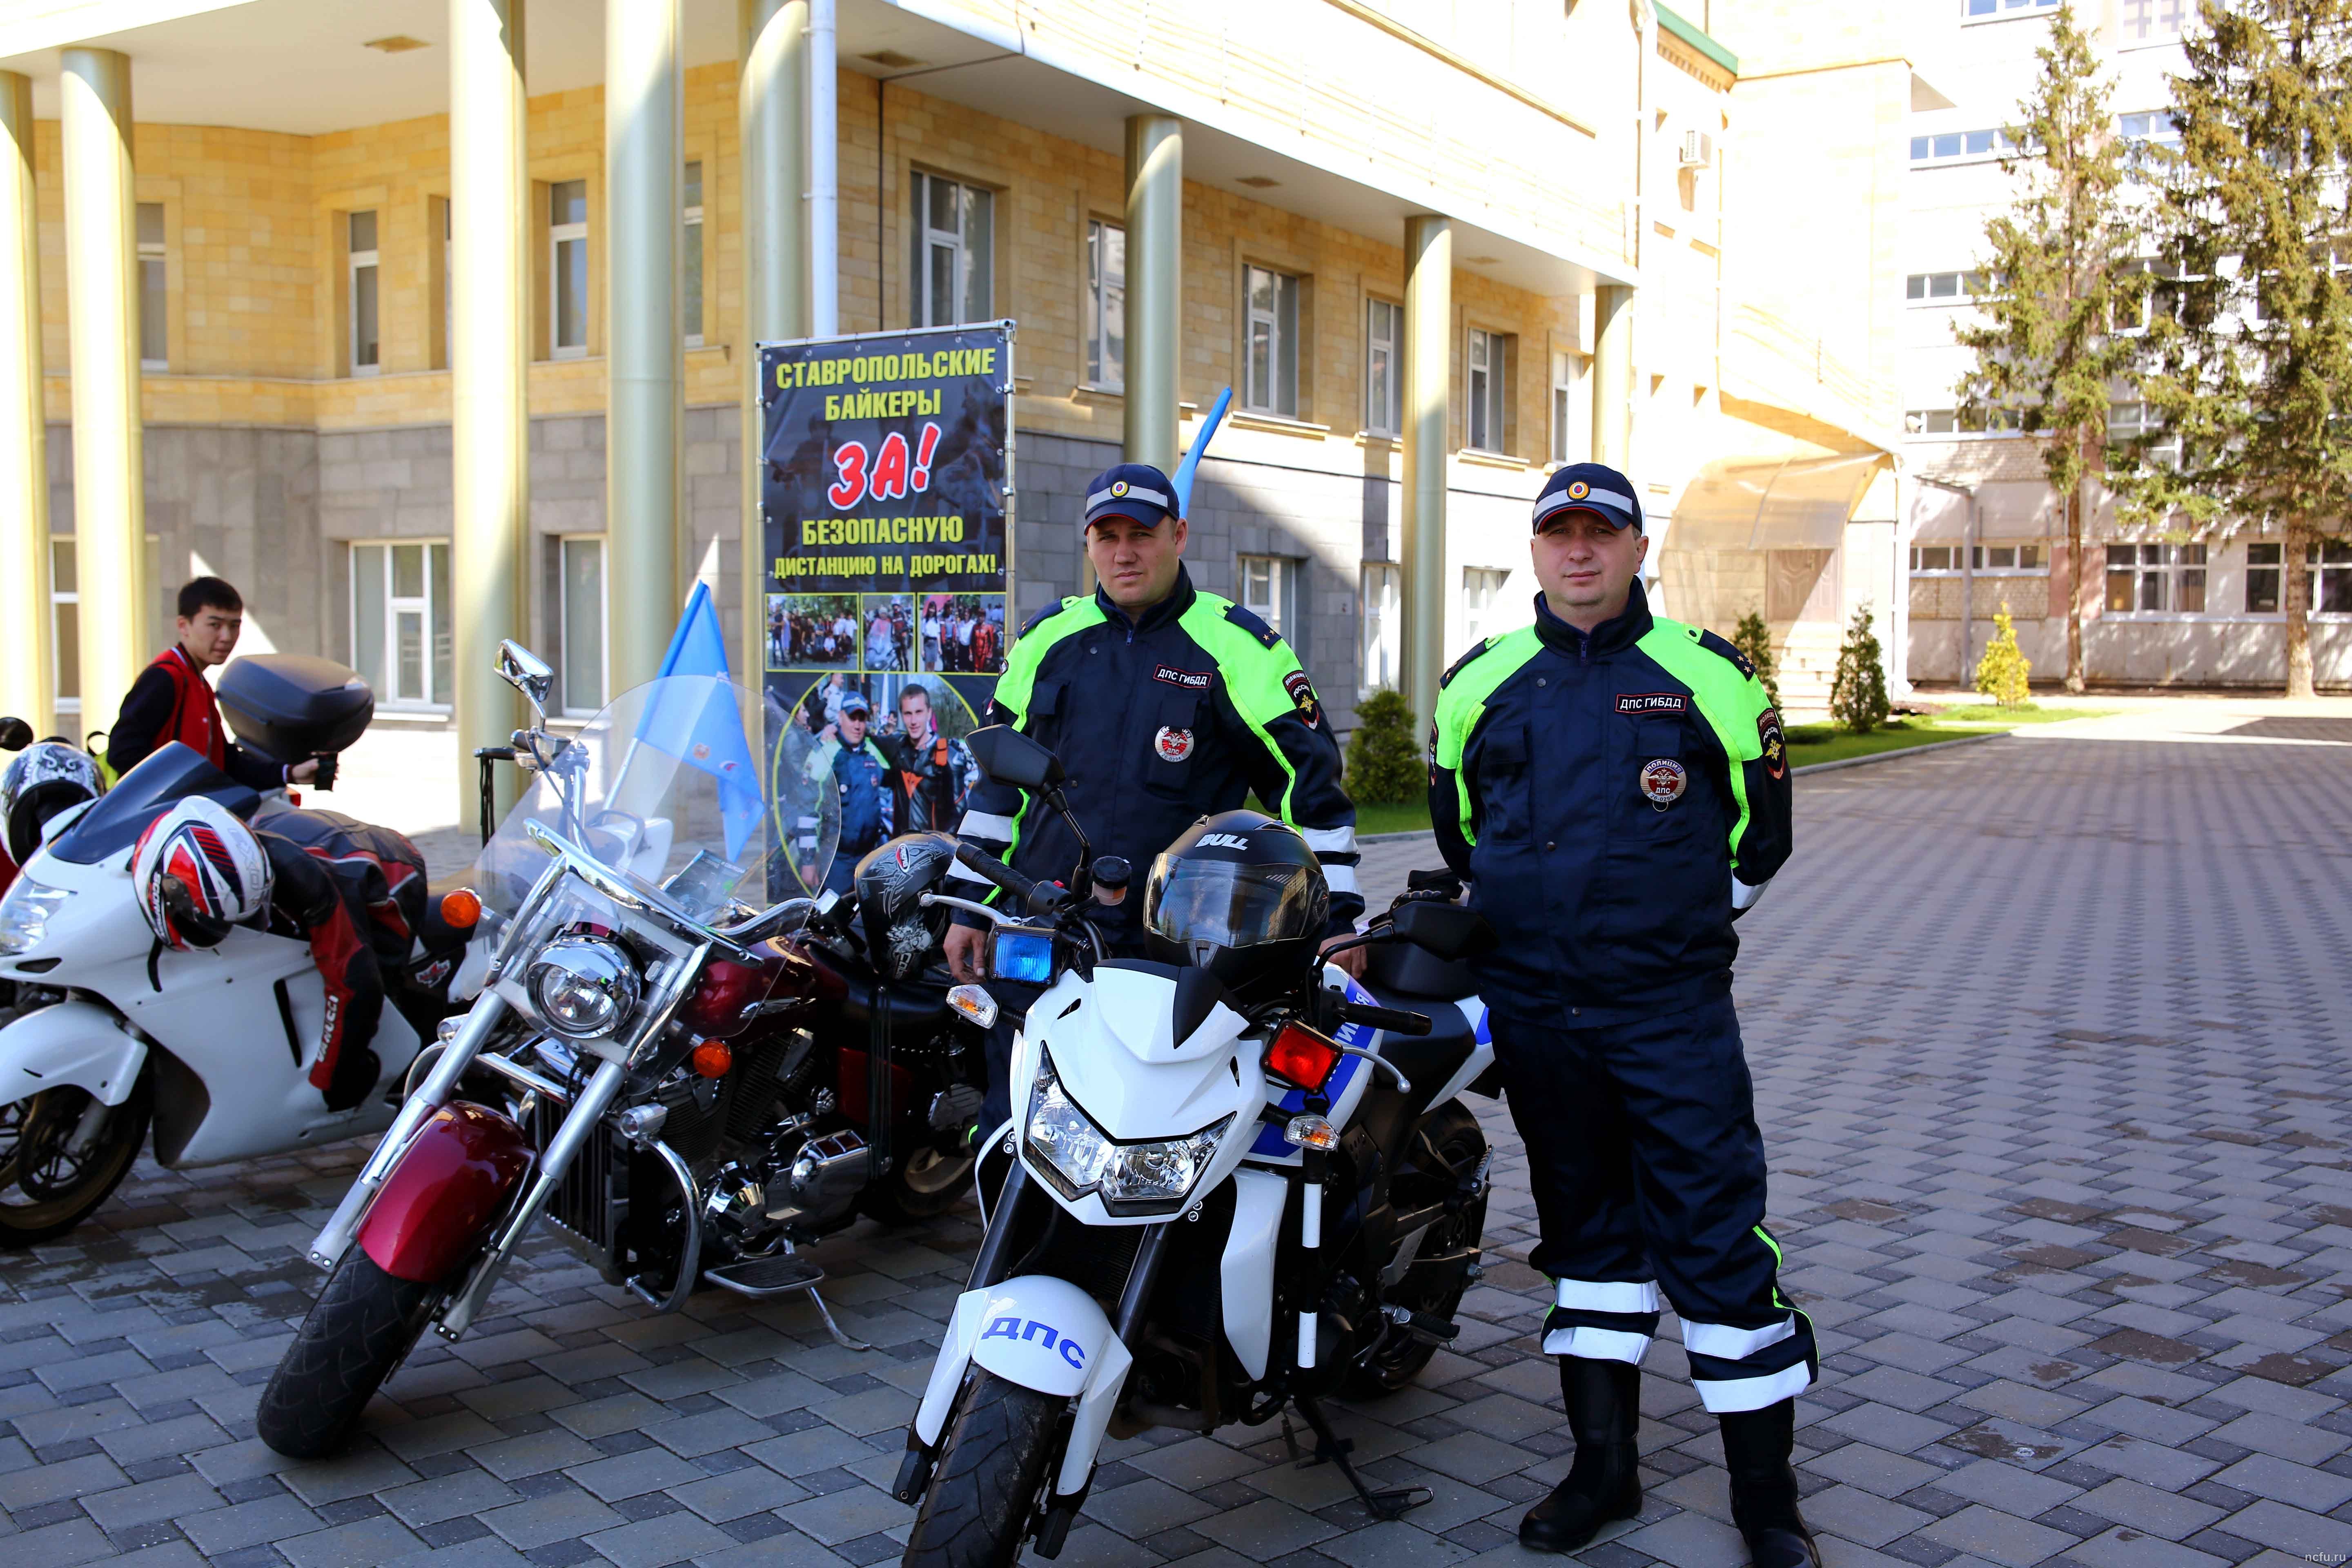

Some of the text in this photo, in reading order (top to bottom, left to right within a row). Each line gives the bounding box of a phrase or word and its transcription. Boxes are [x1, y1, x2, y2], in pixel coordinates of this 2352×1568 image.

[776, 348, 996, 389] СТАВРОПОЛЬСКИЕ
[825, 388, 941, 421] БАЙКЕРЫ
[829, 422, 941, 510] ЗА!
[802, 516, 963, 545] БЕЗОПАСНУЮ
[774, 554, 996, 579] ДИСТАНЦИЮ НА ДОРОГАХ!
[1157, 668, 1207, 686] ДПС ГИБДД
[1620, 697, 1681, 710] ДПС ГИБДД
[1646, 760, 1682, 773] ПОЛИЦИЯ
[1195, 833, 1248, 850] BULL
[981, 1317, 1085, 1369] ДПС
